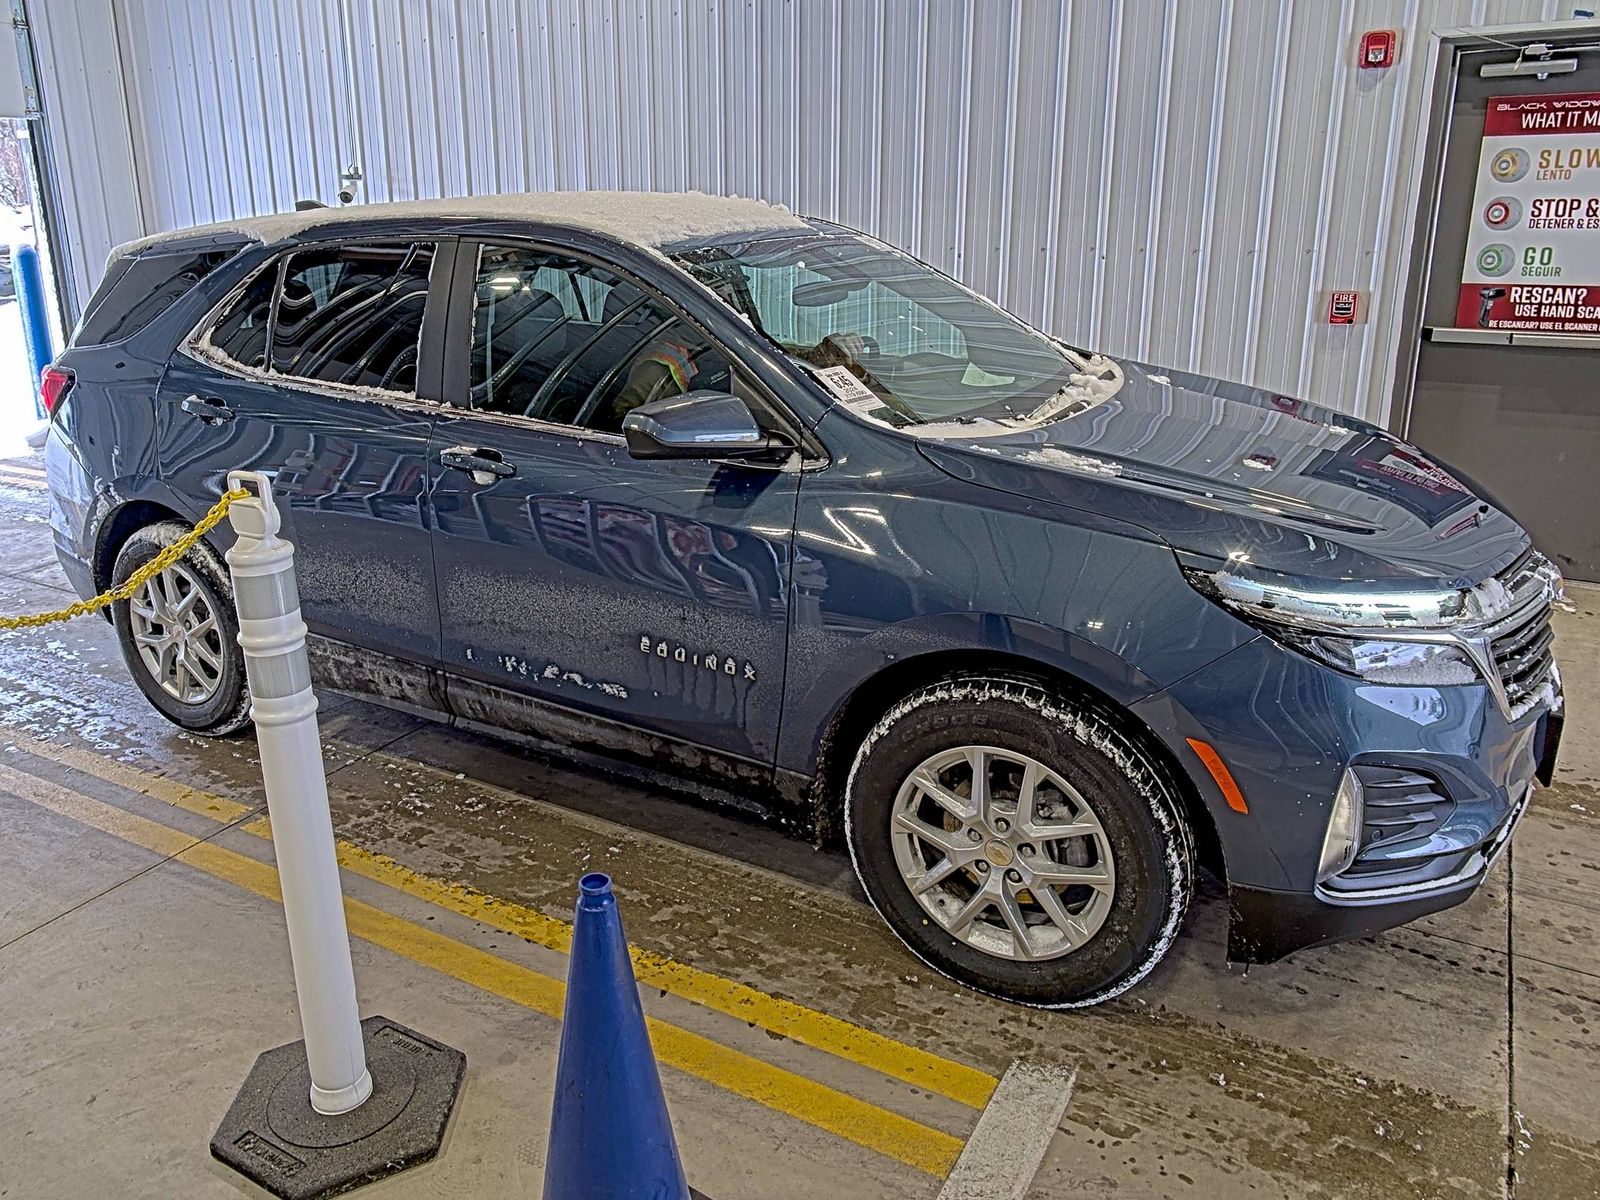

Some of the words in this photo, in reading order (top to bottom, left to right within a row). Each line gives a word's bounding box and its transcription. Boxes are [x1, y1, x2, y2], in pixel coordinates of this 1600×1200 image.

[1497, 102, 1547, 111] BLACK
[1522, 111, 1565, 129] WHAT
[1567, 111, 1581, 127] IT
[1583, 110, 1600, 127] M
[1539, 149, 1600, 169] SLOW
[1536, 169, 1572, 180] LENTO
[1531, 198, 1582, 218] STOP
[1585, 198, 1599, 218] &
[1528, 218, 1575, 229] DETENER
[1576, 218, 1585, 229] &
[1586, 218, 1600, 229] ES
[1523, 246, 1553, 266] GO
[1521, 266, 1562, 277] SEGUIR
[1333, 293, 1355, 301] FIRE
[1510, 287, 1587, 304] RESCAN?
[1514, 304, 1538, 317] USE
[1540, 305, 1575, 318] HAND
[1488, 320, 1498, 328] RE
[1499, 320, 1539, 329] ESCANEAR?
[1540, 321, 1554, 330] USE
[1554, 322, 1563, 330] EL
[1564, 322, 1598, 331] SCANNER
